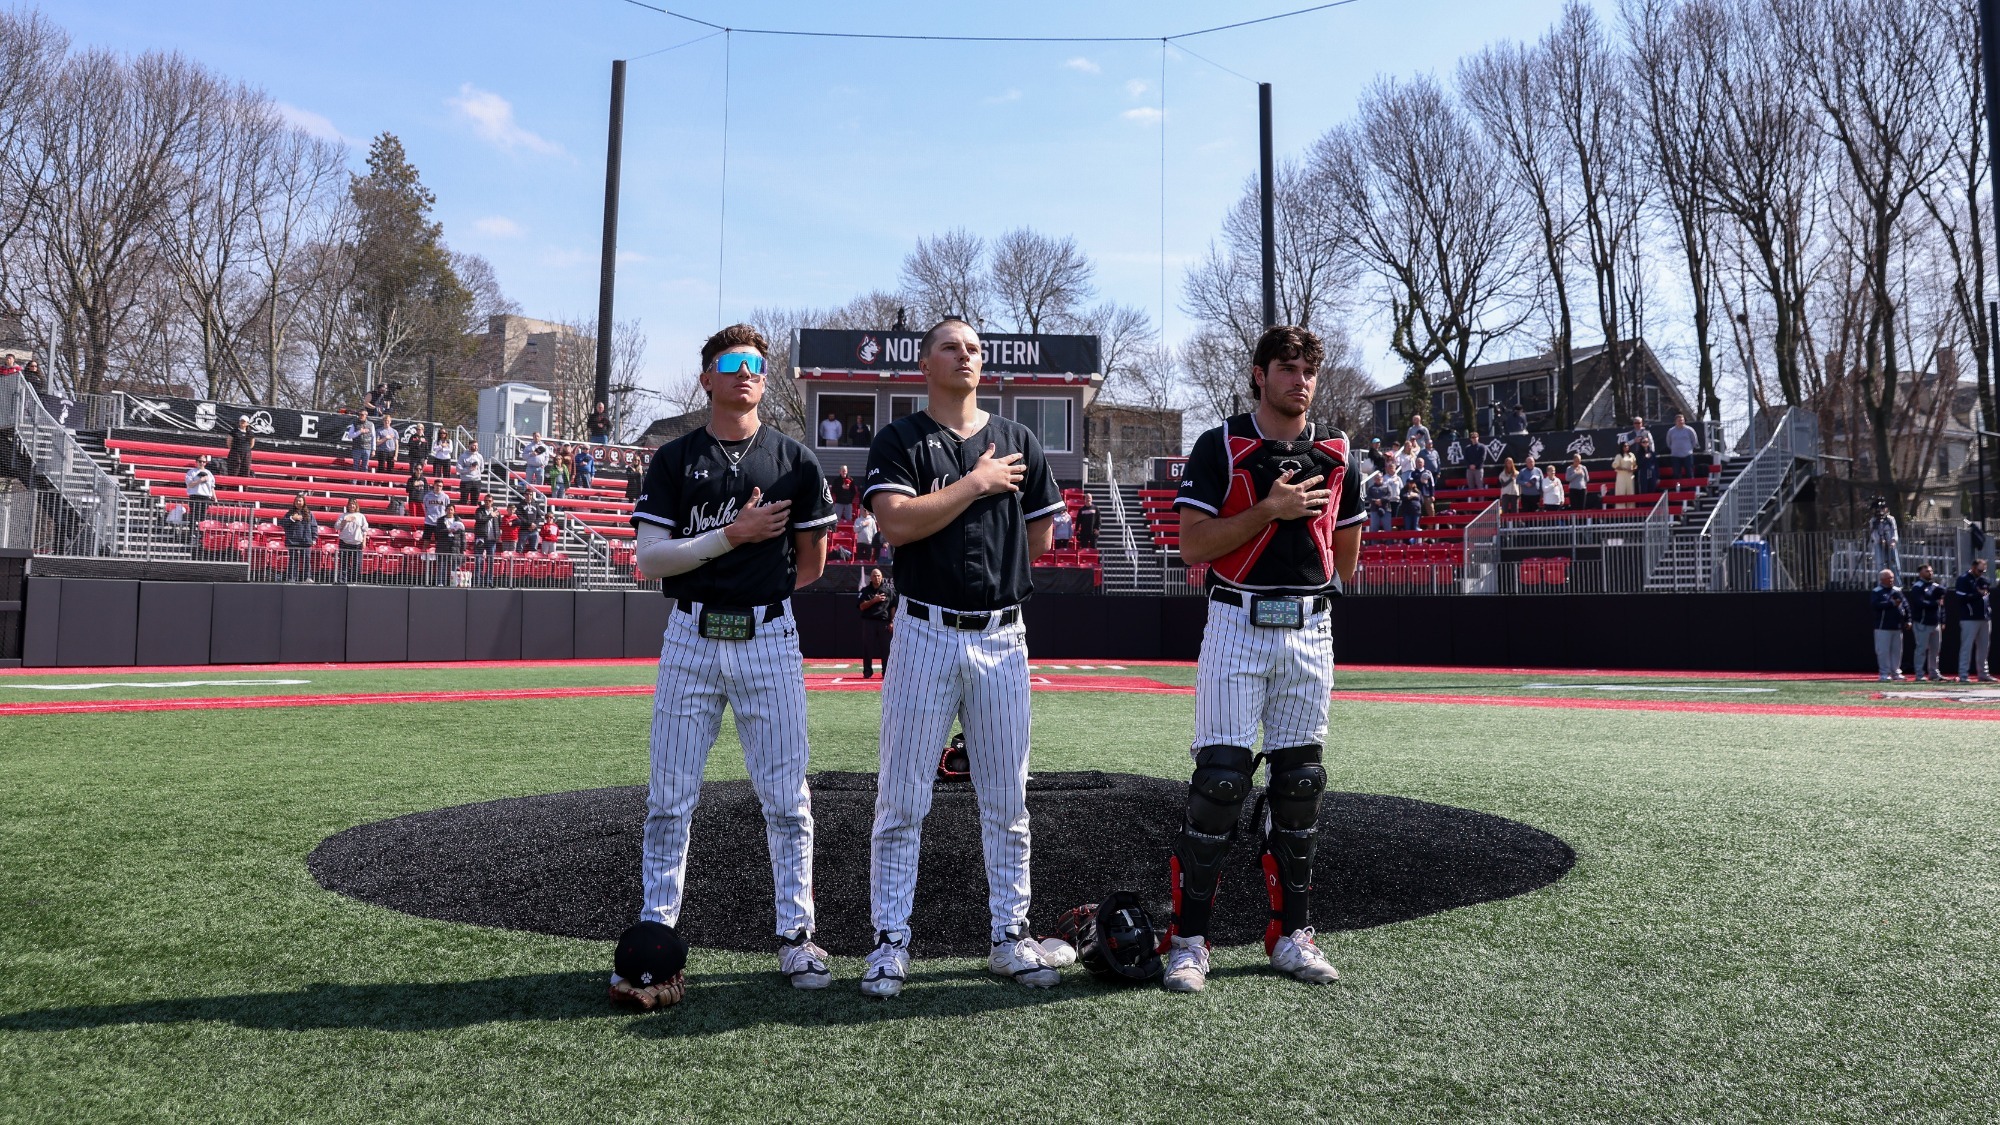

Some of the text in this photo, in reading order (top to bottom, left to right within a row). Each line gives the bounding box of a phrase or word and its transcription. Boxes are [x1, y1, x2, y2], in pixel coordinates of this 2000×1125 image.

[885, 337, 1040, 365] NORSTERN
[300, 414, 319, 438] E
[1171, 463, 1186, 477] 67
